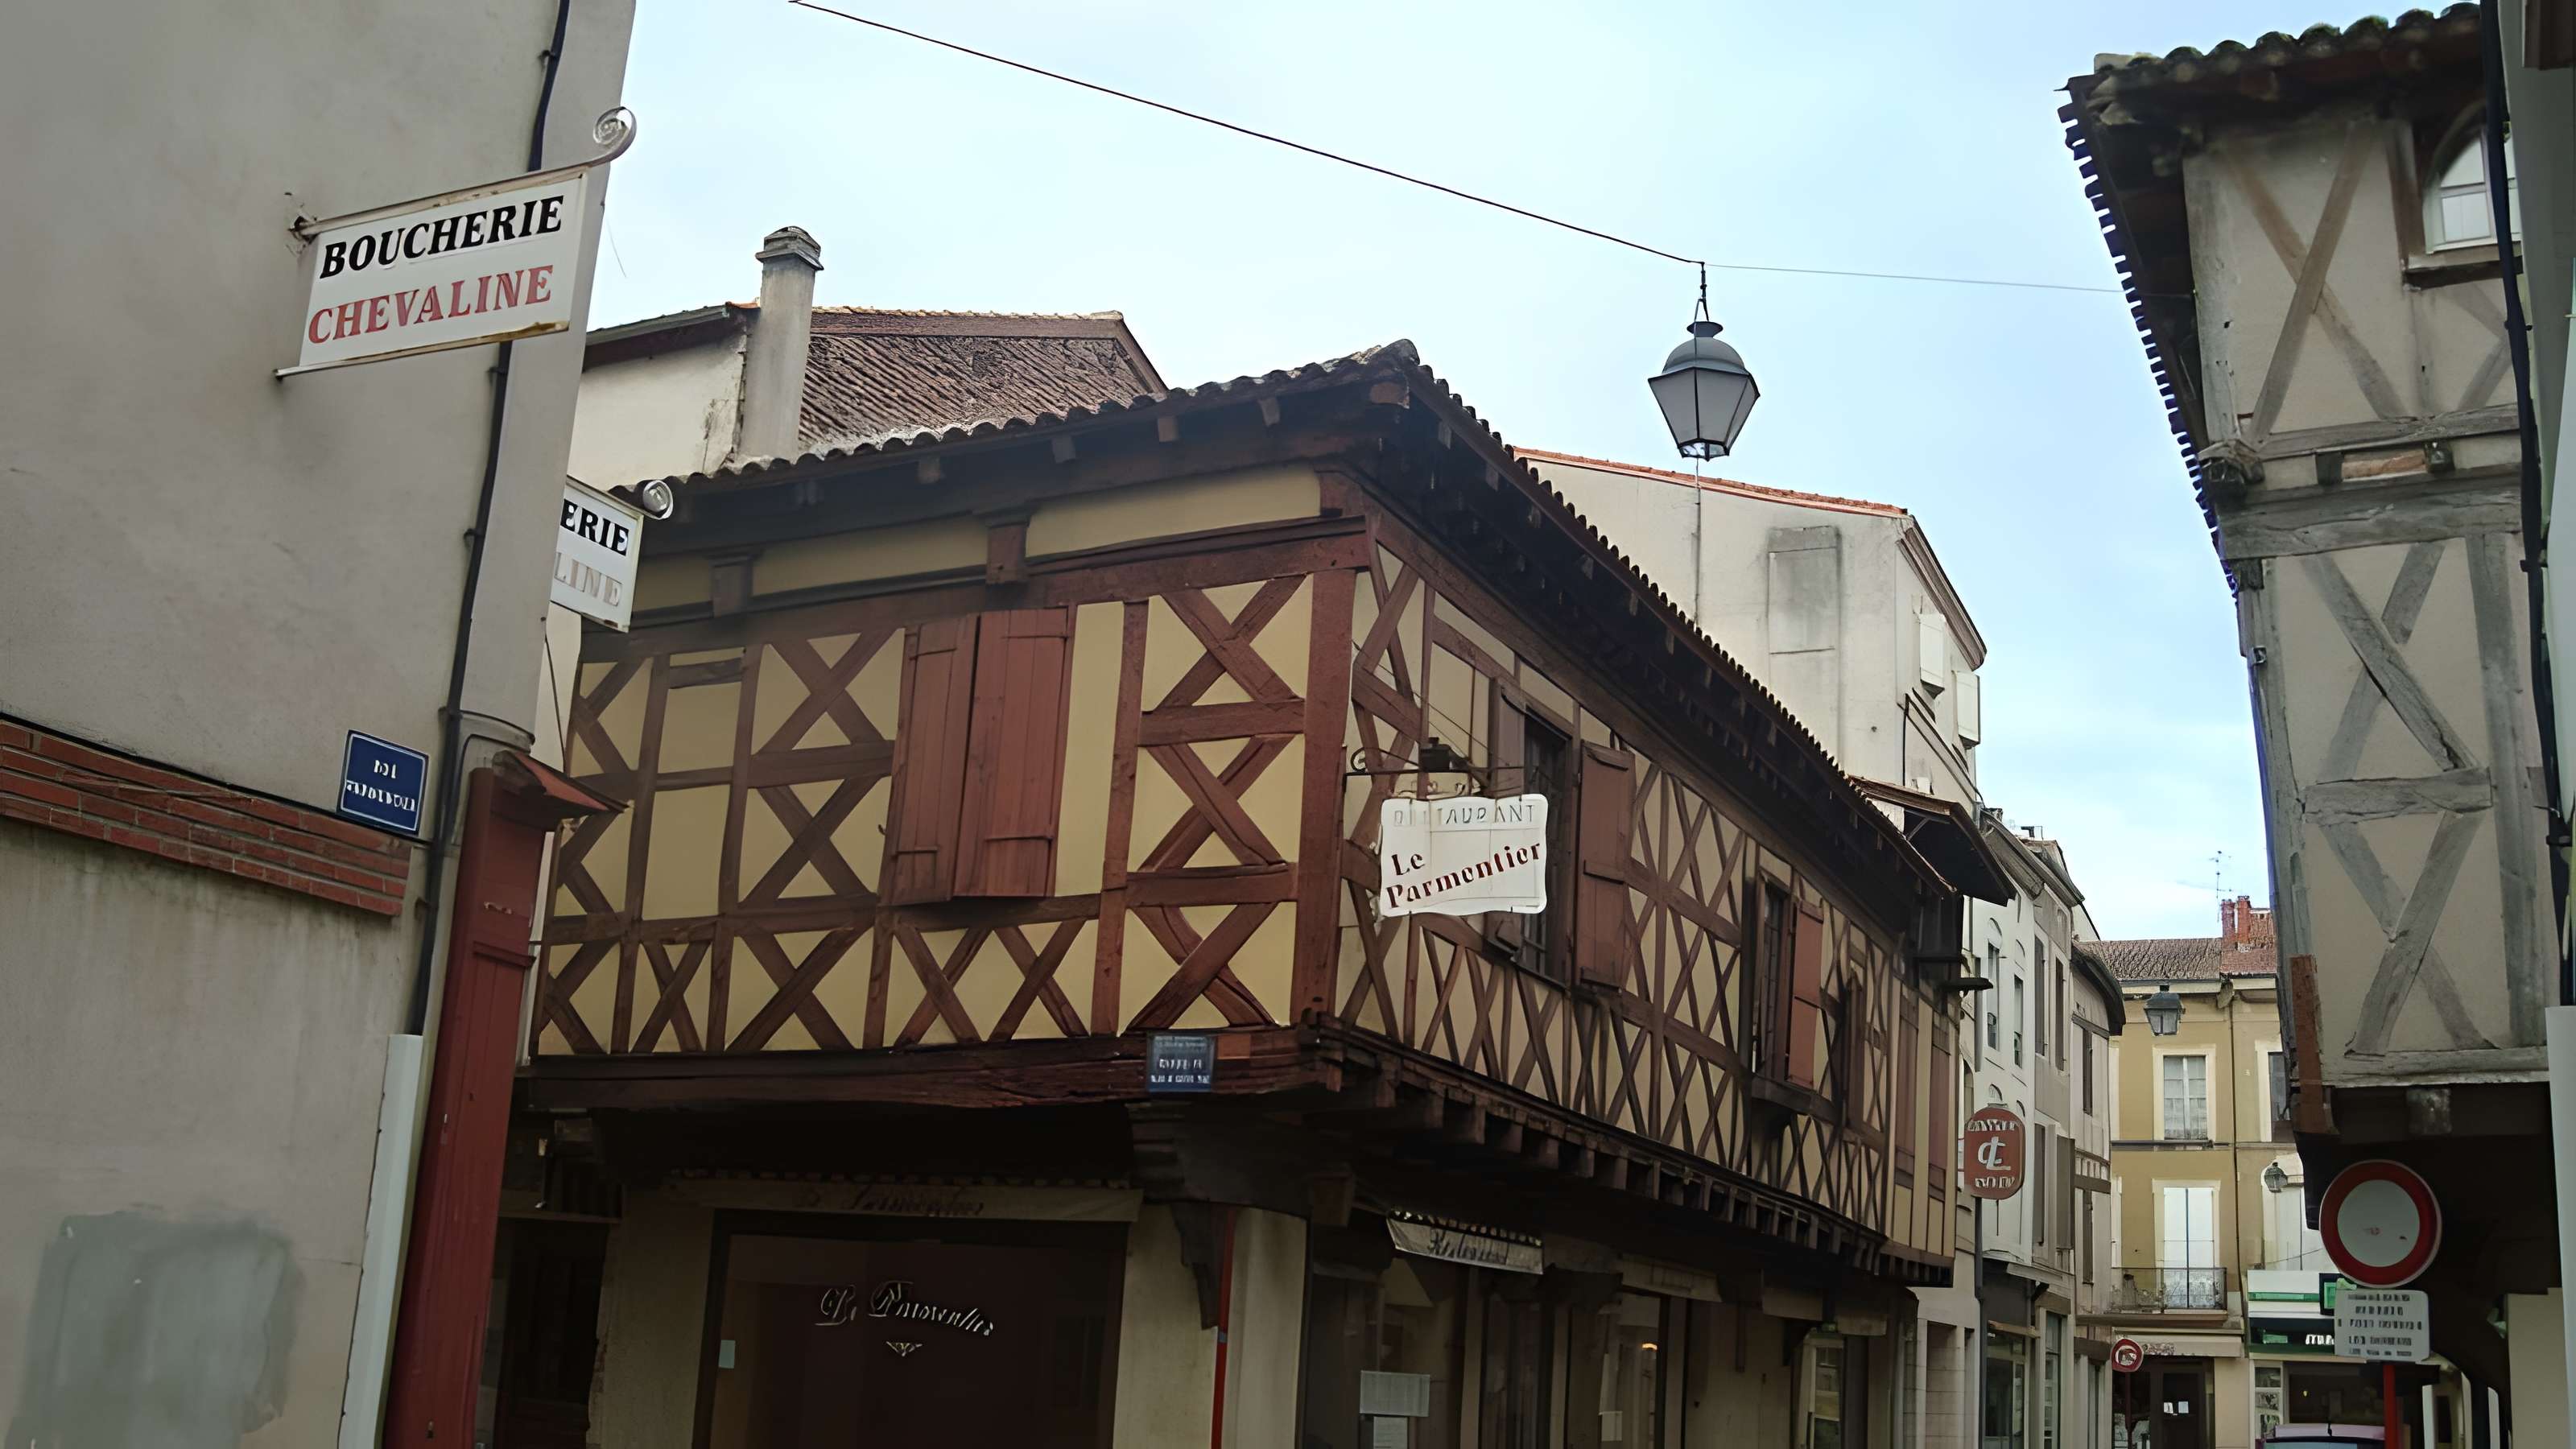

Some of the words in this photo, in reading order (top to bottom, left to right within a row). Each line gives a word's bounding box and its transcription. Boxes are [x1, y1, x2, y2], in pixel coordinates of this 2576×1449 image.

[320, 195, 564, 279] BOUCHERIE
[308, 264, 555, 345] CHEVALINE
[1385, 843, 1541, 909] Parmentier
[1391, 852, 1426, 877] Le
